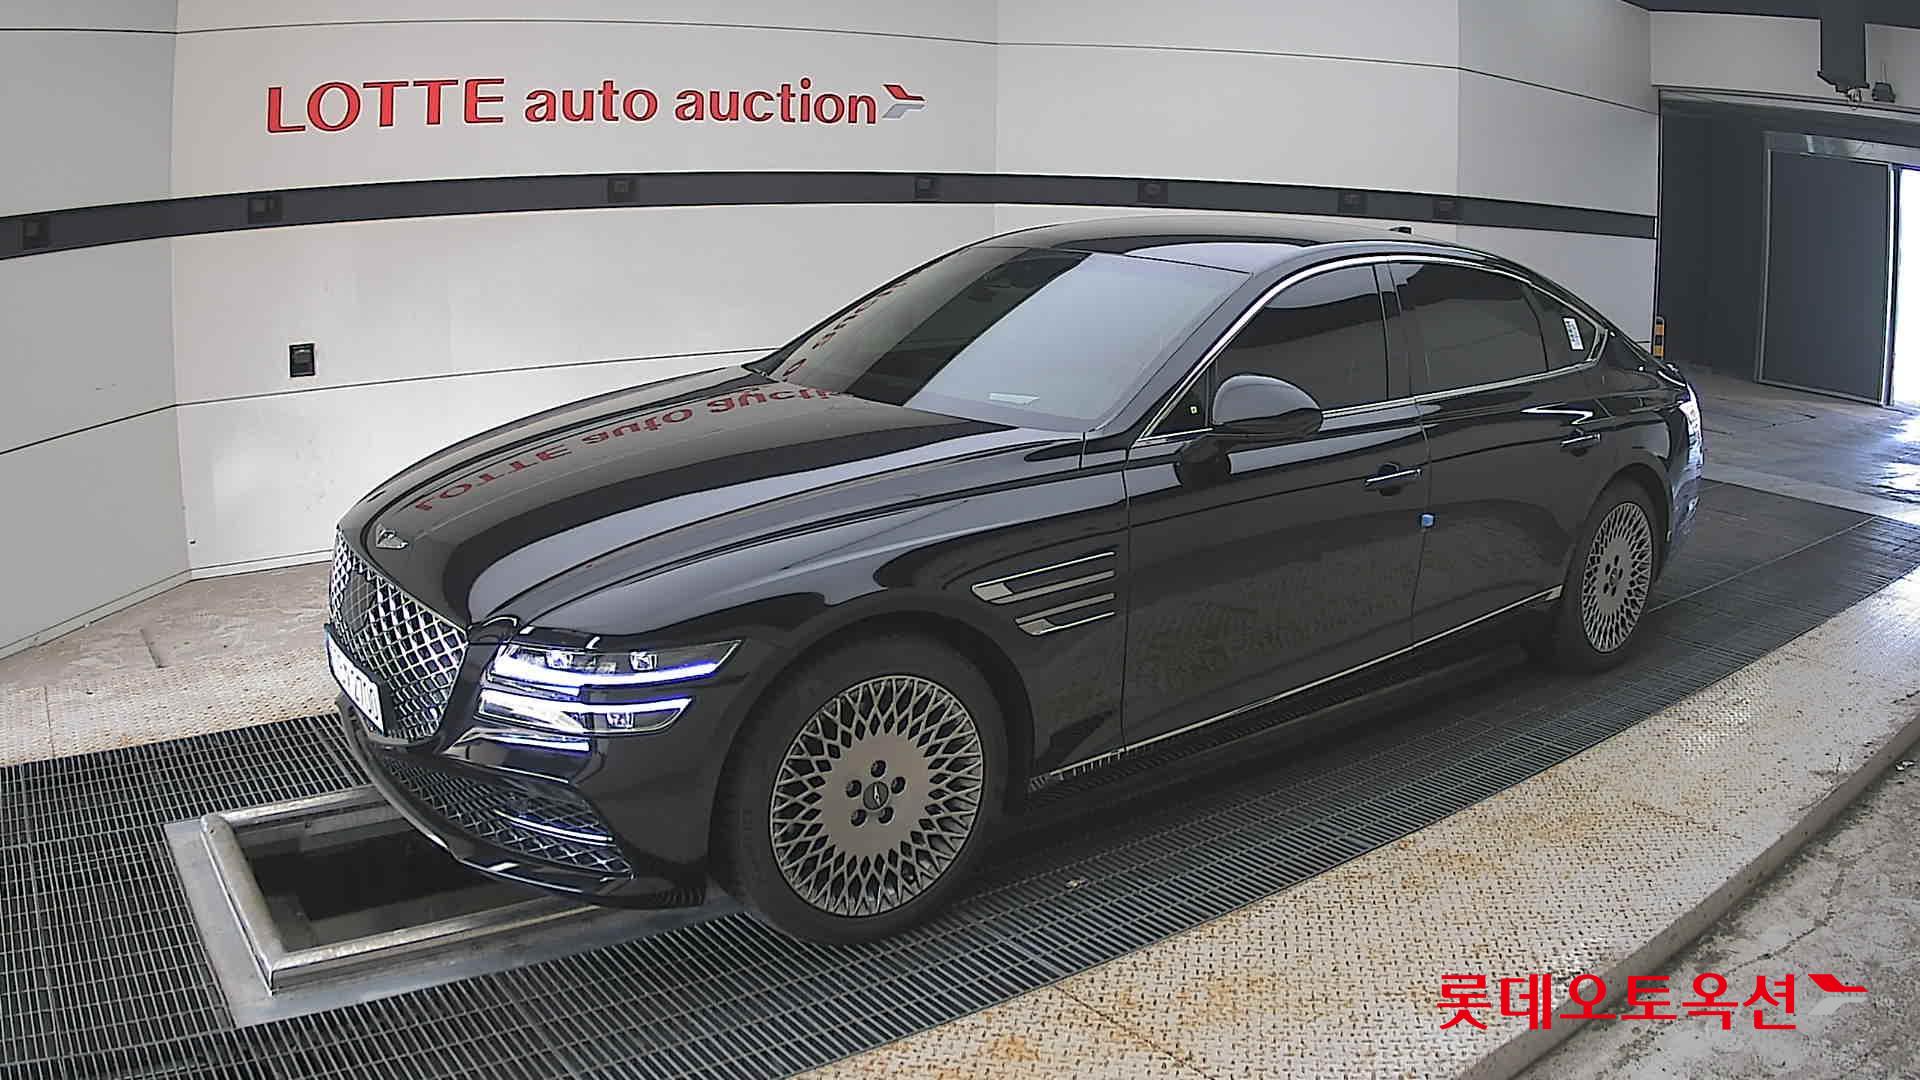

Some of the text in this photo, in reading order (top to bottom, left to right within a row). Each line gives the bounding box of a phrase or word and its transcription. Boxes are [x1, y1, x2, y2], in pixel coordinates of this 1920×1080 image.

[266, 77, 878, 134] LOTTE auto auction
